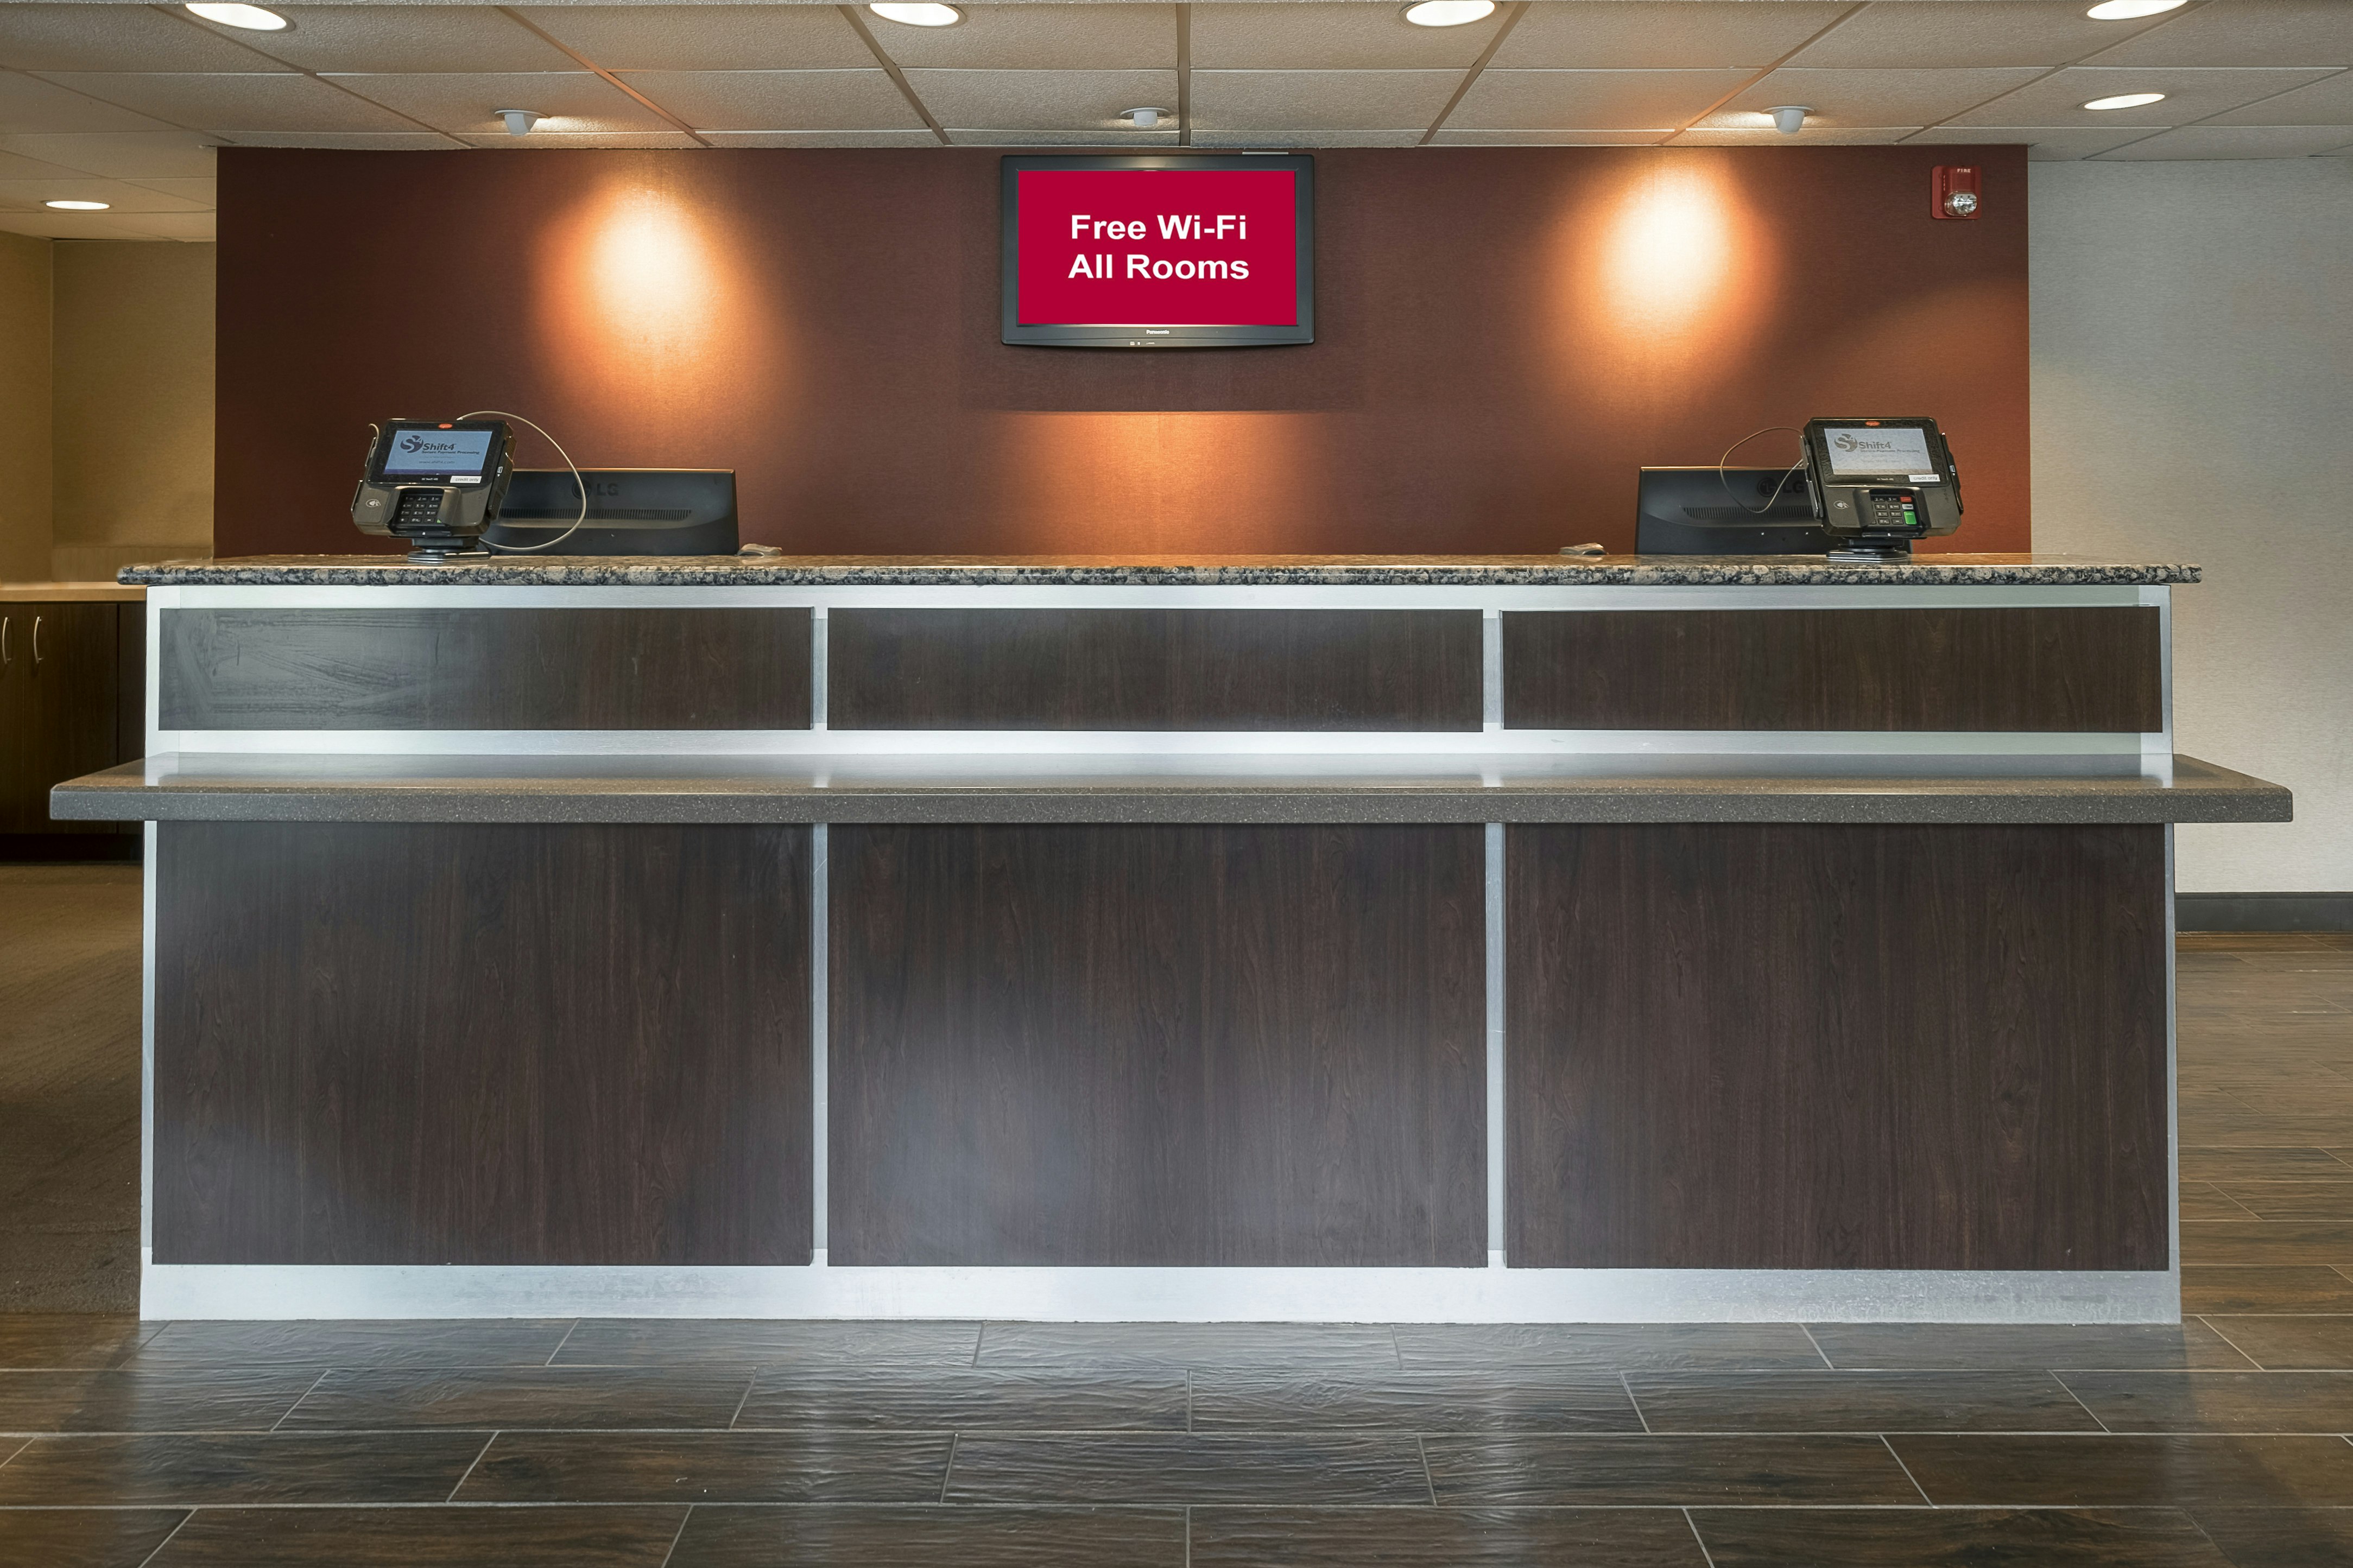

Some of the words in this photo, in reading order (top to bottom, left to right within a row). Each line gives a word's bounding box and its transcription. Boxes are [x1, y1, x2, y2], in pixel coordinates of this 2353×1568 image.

[1071, 215, 1147, 240] Free
[1157, 215, 1247, 240] Wi-Fi
[1068, 254, 1113, 279] All
[1127, 254, 1250, 280] Rooms
[1858, 441, 1892, 449] Shift4
[597, 483, 619, 496] LG
